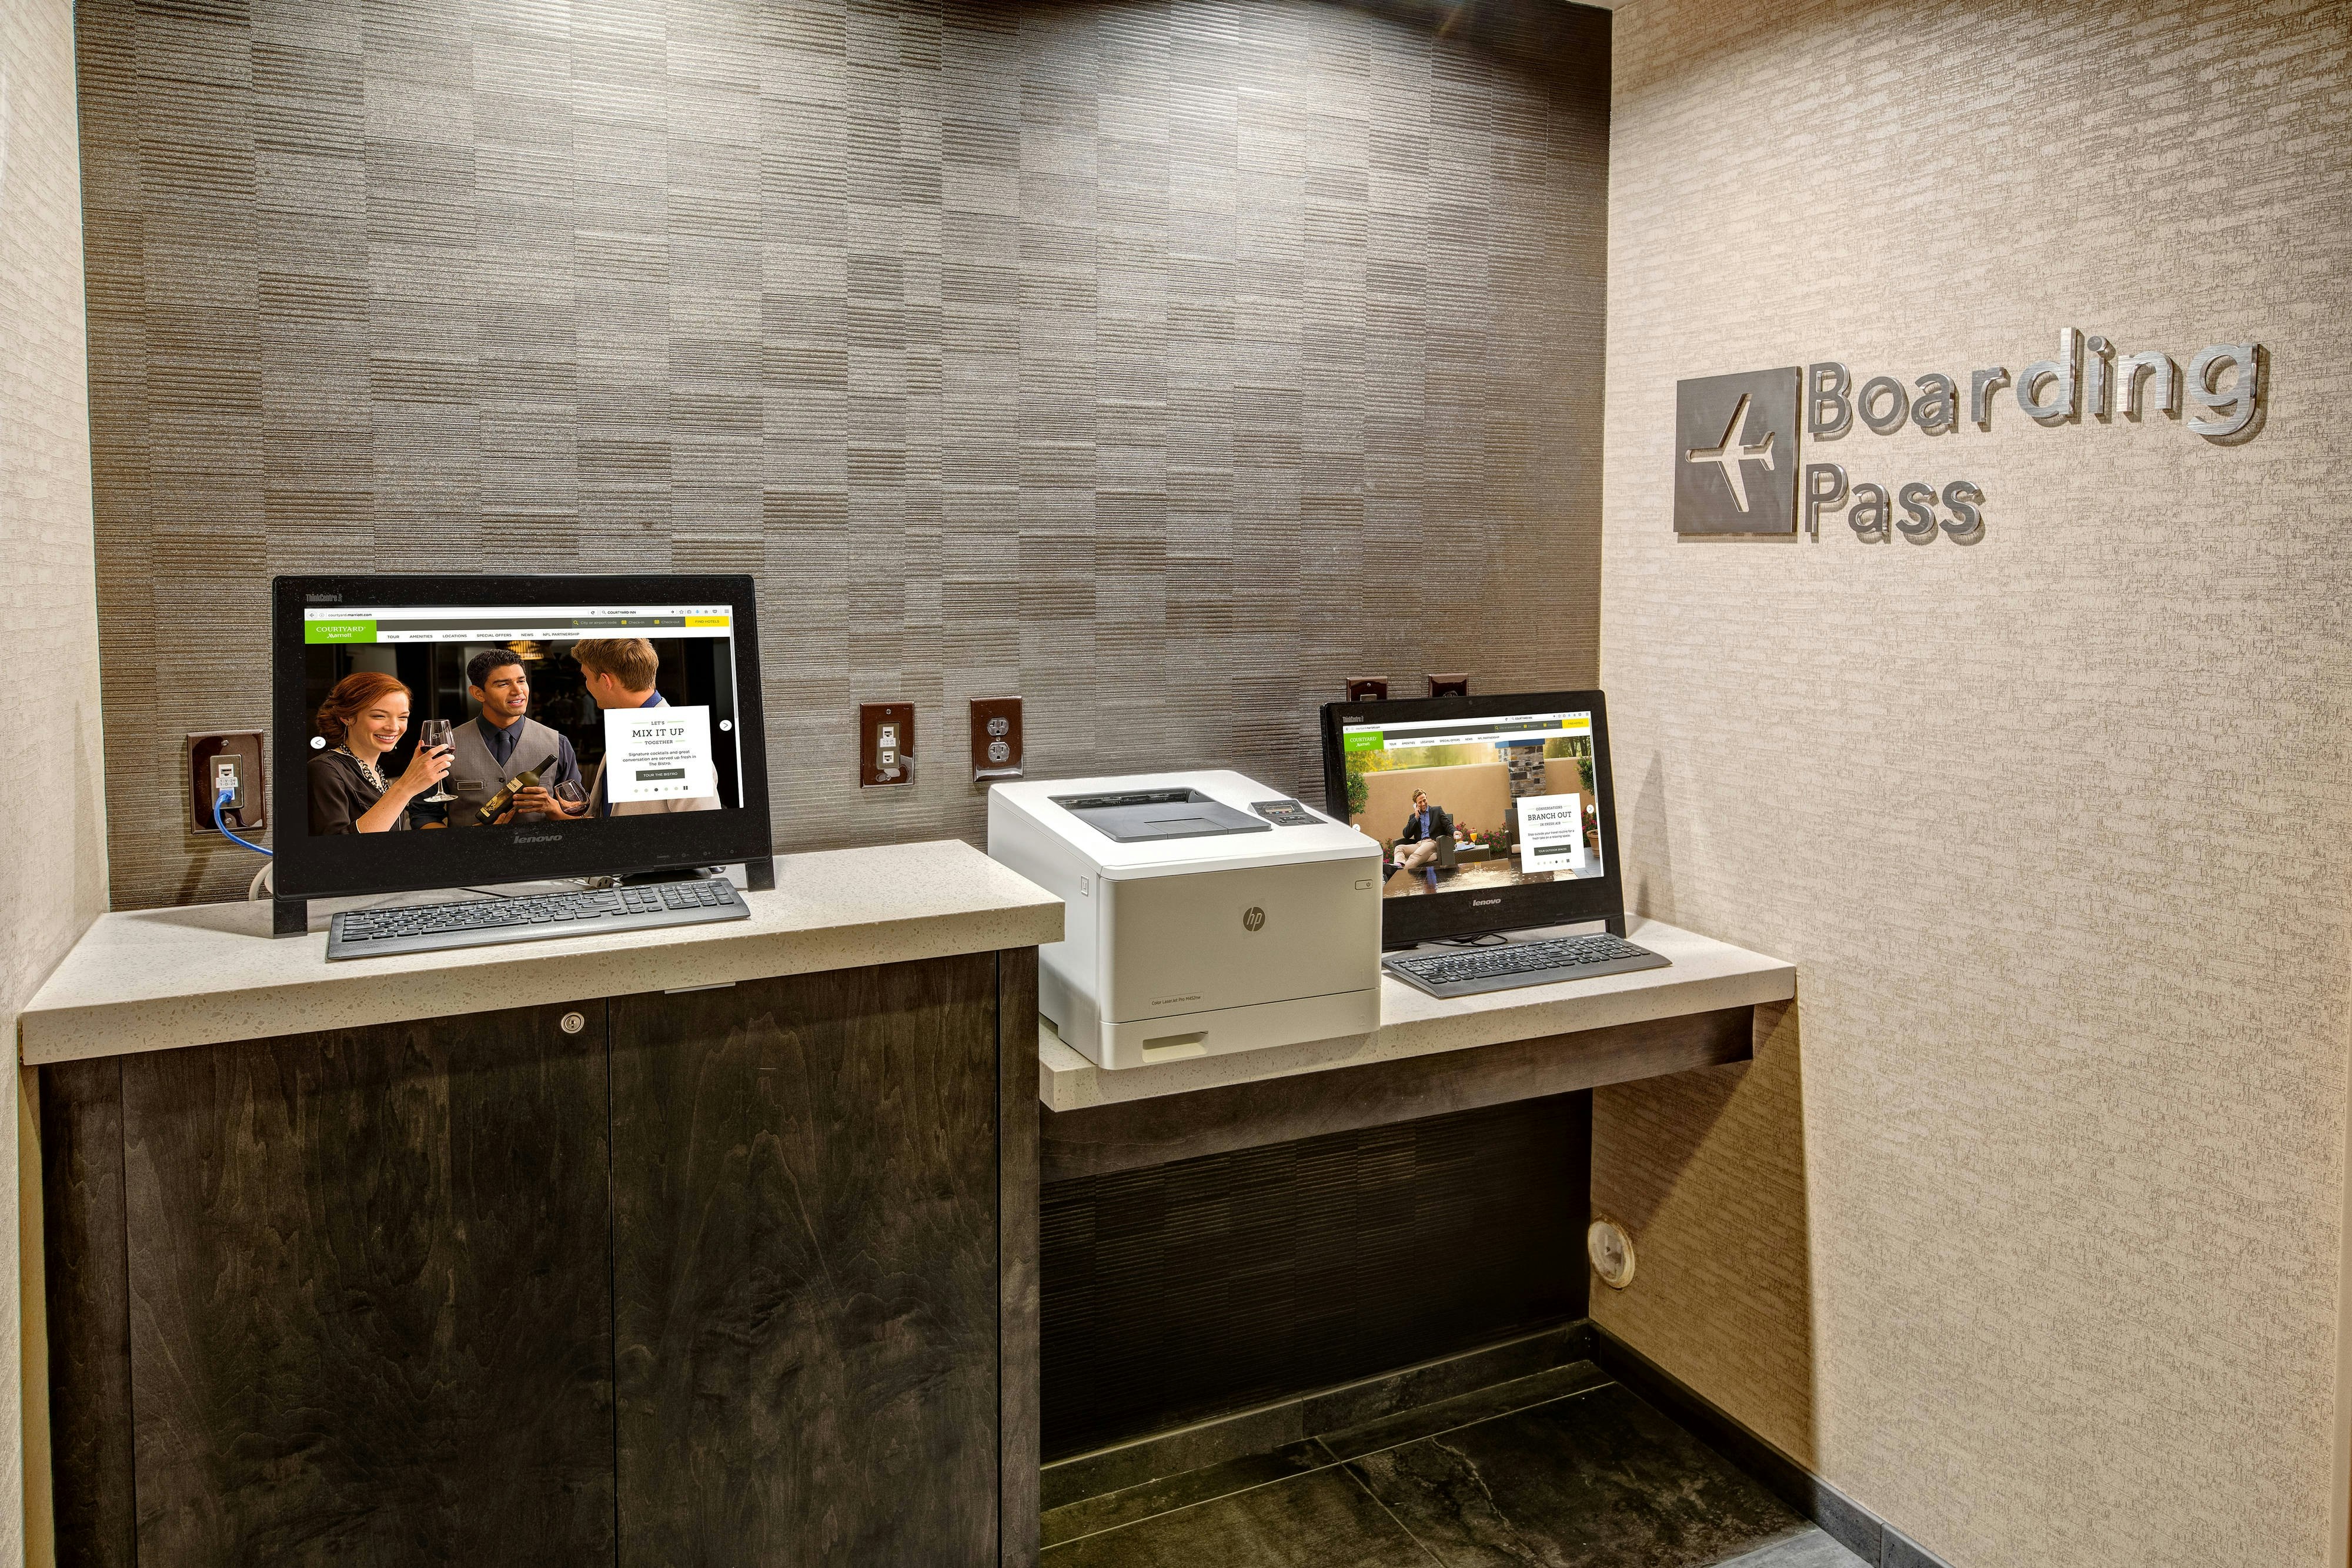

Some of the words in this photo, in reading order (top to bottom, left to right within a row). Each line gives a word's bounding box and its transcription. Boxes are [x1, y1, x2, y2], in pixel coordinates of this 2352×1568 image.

[1808, 327, 2259, 436] Boarding
[1805, 463, 1983, 536] Pass
[306, 594, 337, 602] ThinkCentre
[632, 729, 652, 737] MIX
[513, 835, 563, 844] lenovo
[1246, 907, 1263, 931] hp
